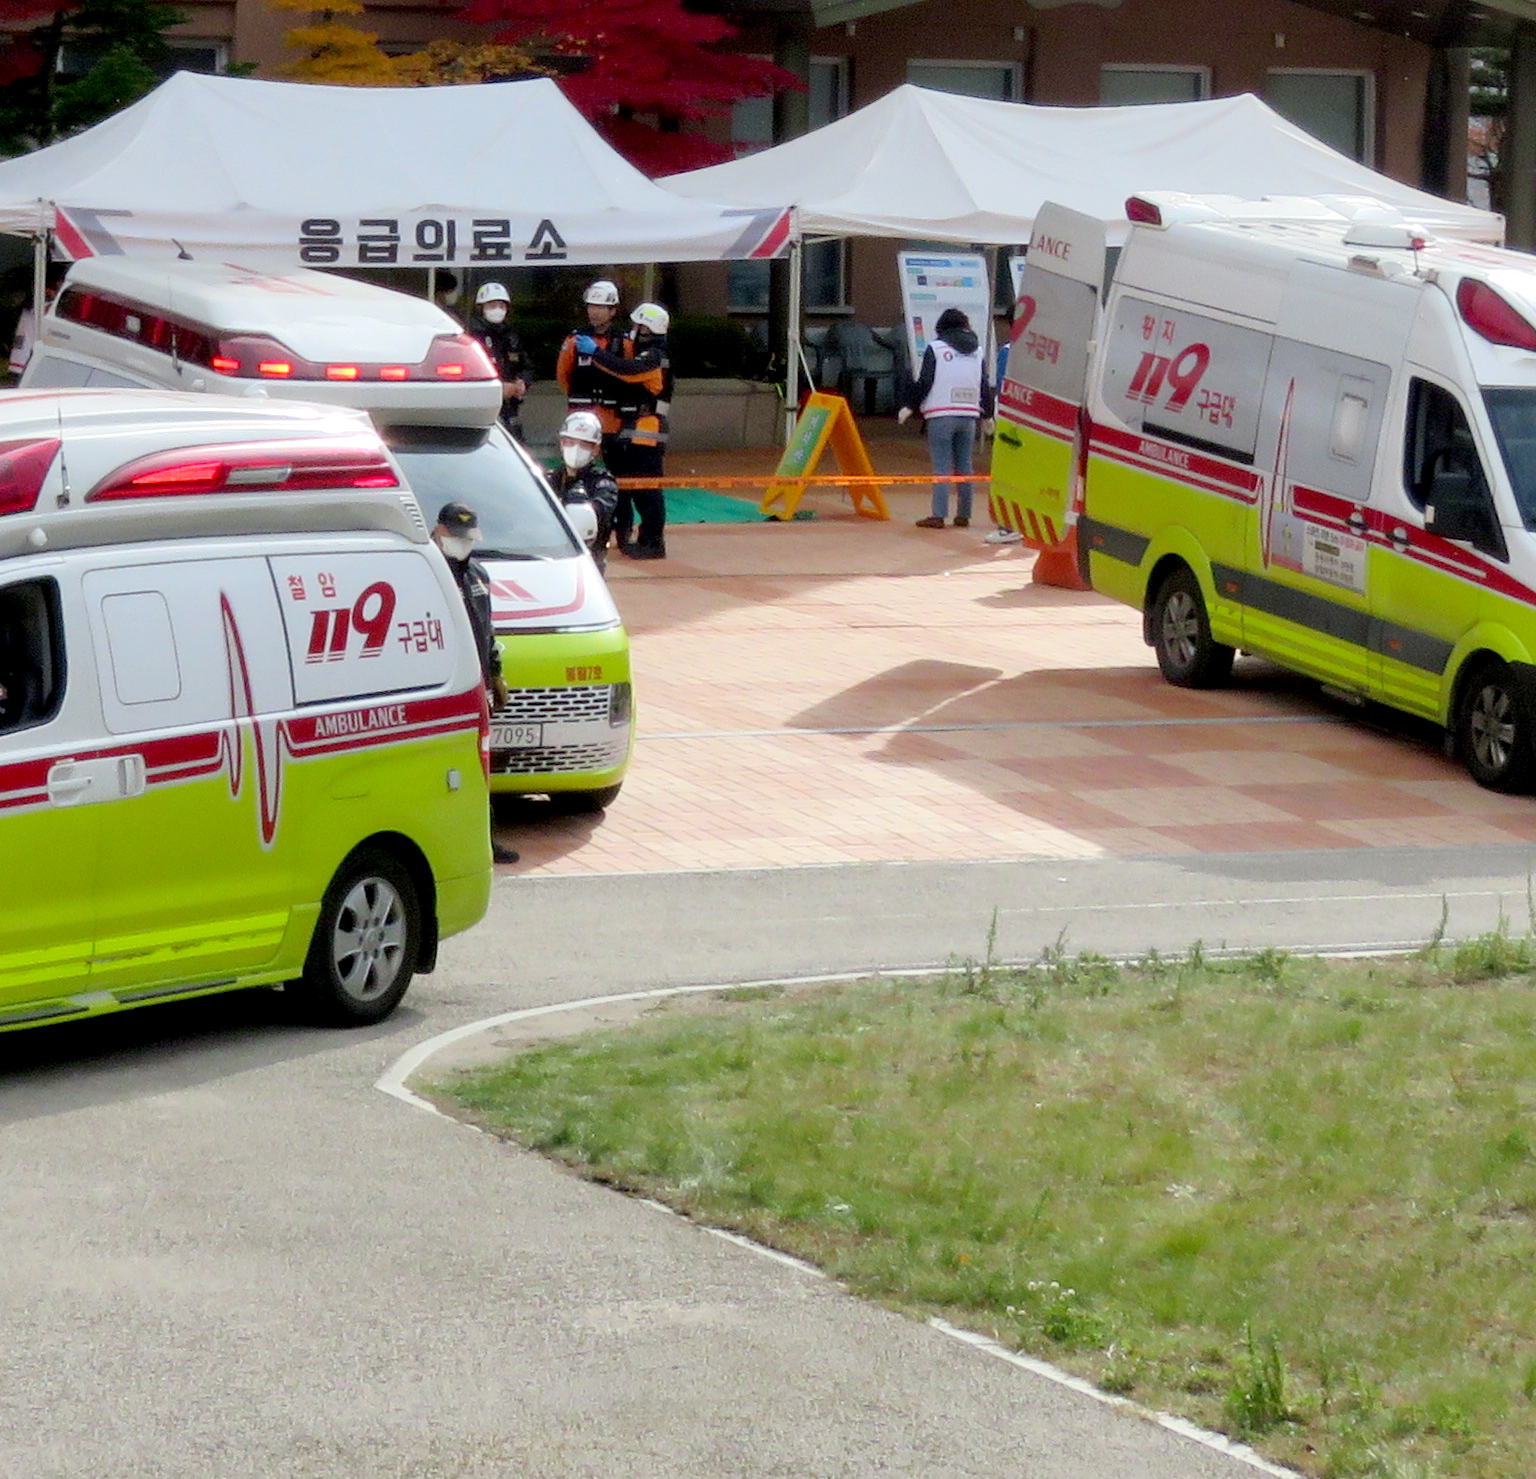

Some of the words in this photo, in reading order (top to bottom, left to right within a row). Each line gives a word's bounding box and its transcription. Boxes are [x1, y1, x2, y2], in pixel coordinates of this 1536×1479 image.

[299, 218, 568, 263] 응급의료소
[1125, 342, 1211, 413] 119
[1196, 388, 1237, 430] 구급대
[1138, 439, 1190, 469] AMBULANCE
[304, 581, 396, 664] 119
[397, 619, 445, 654] 구급대
[314, 705, 408, 738] AMBULANCE
[492, 727, 536, 744] 7095
